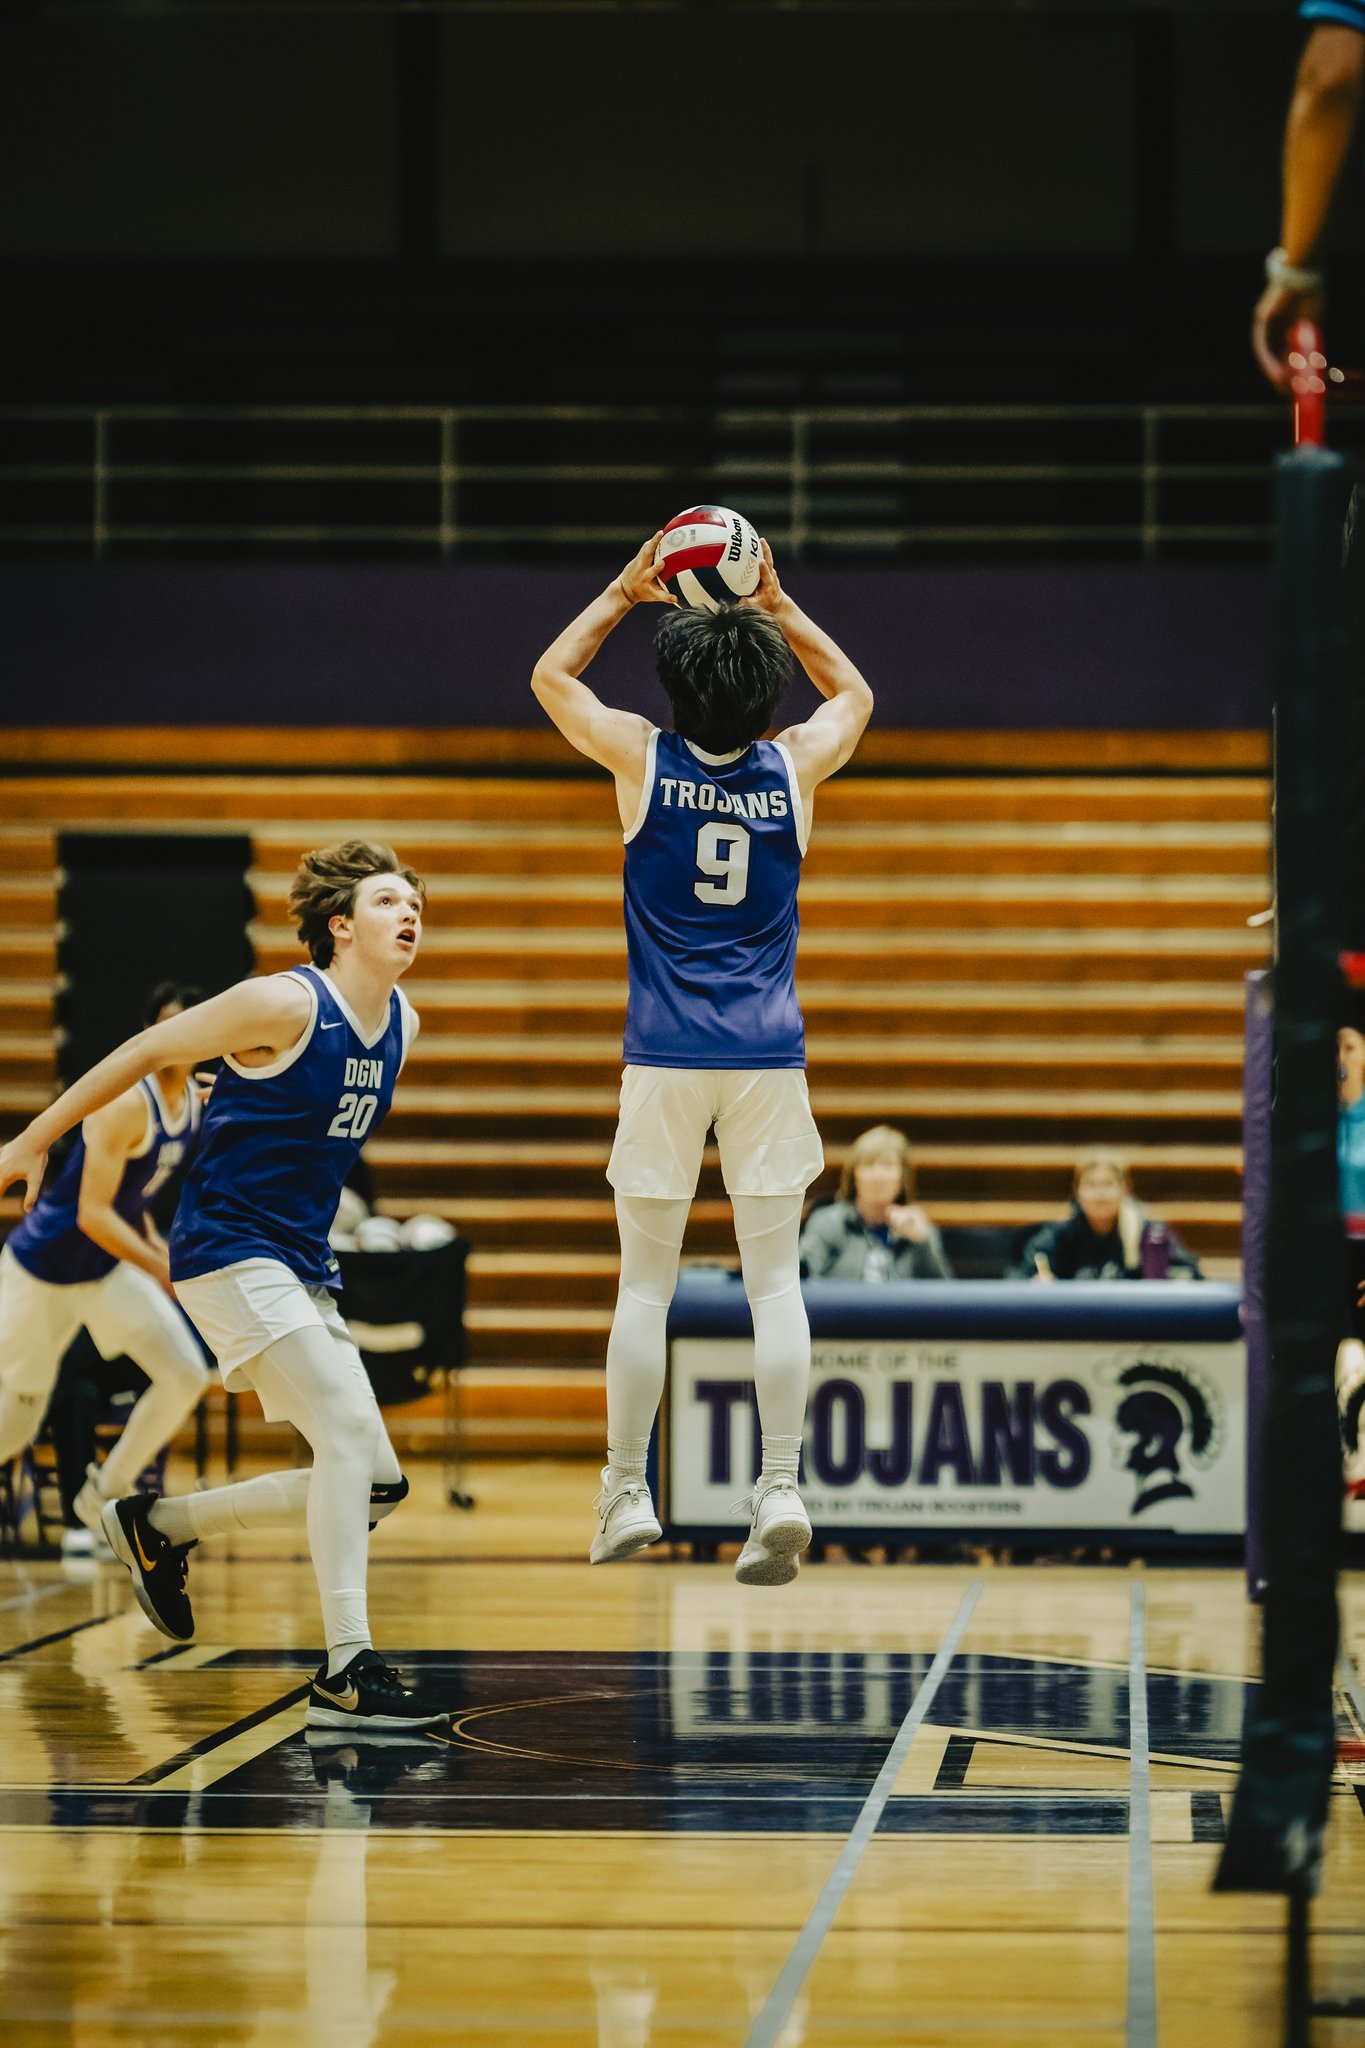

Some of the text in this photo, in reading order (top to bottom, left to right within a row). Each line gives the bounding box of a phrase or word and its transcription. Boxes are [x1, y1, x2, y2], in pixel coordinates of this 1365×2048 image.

[728, 519, 742, 562] Wilson
[660, 778, 788, 818] TROJANS
[694, 821, 751, 906] 9
[343, 1057, 384, 1089] DGN
[326, 1092, 378, 1138] 20
[879, 1354, 907, 1368] OF
[918, 1354, 959, 1368] THE
[695, 1379, 1091, 1488] TOJANS
